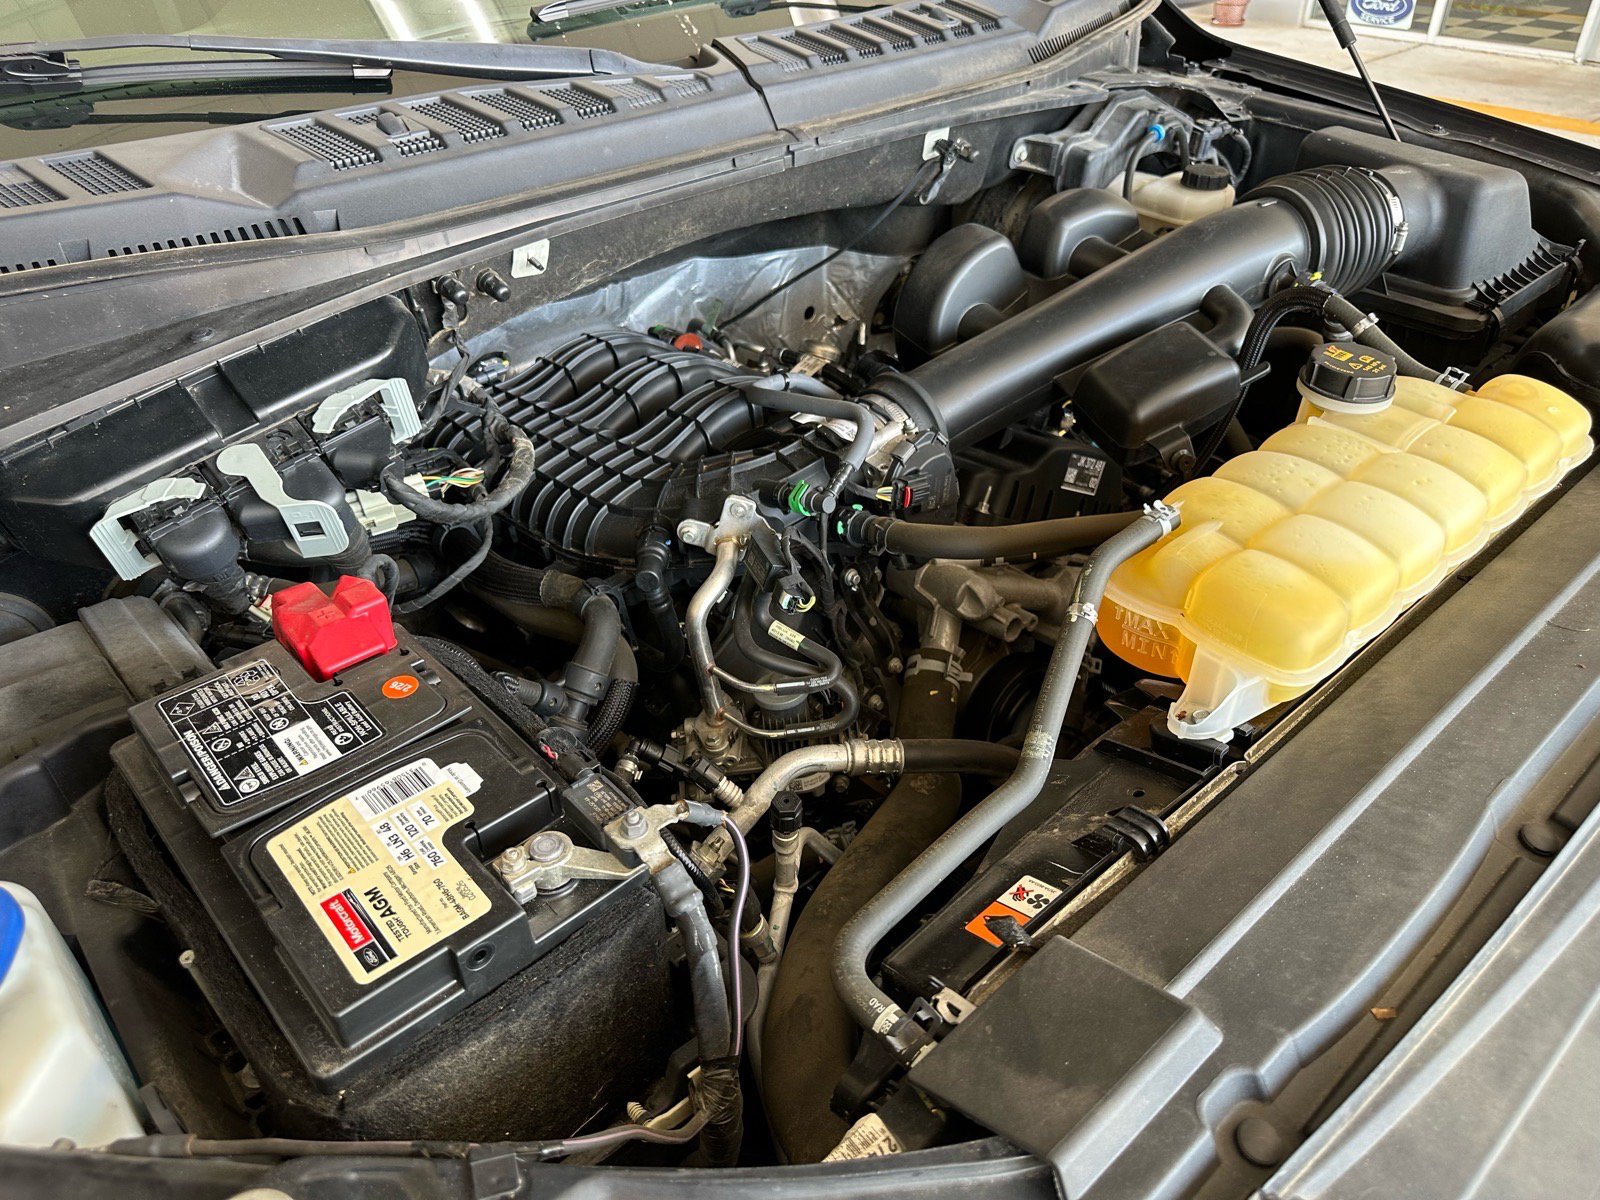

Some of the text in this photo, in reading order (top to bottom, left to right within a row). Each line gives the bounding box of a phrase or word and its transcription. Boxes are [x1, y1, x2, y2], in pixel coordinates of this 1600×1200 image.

[1121, 630, 1167, 660] MIN
[334, 701, 367, 736] NON-SPILLABLE
[182, 729, 226, 786] DANGER/POISON
[282, 737, 304, 761] WARNING:
[404, 823, 419, 837] 120
[421, 814, 435, 825] 70
[379, 821, 414, 860] H6 LN3 48
[426, 850, 444, 866] 760
[363, 885, 396, 920] AGM
[432, 877, 469, 920] BAGM-48H6-760
[327, 898, 365, 944] Motorcraft
[385, 919, 405, 942] TESTED
[410, 908, 432, 934] Manufactured
[868, 998, 886, 1014] RAD
